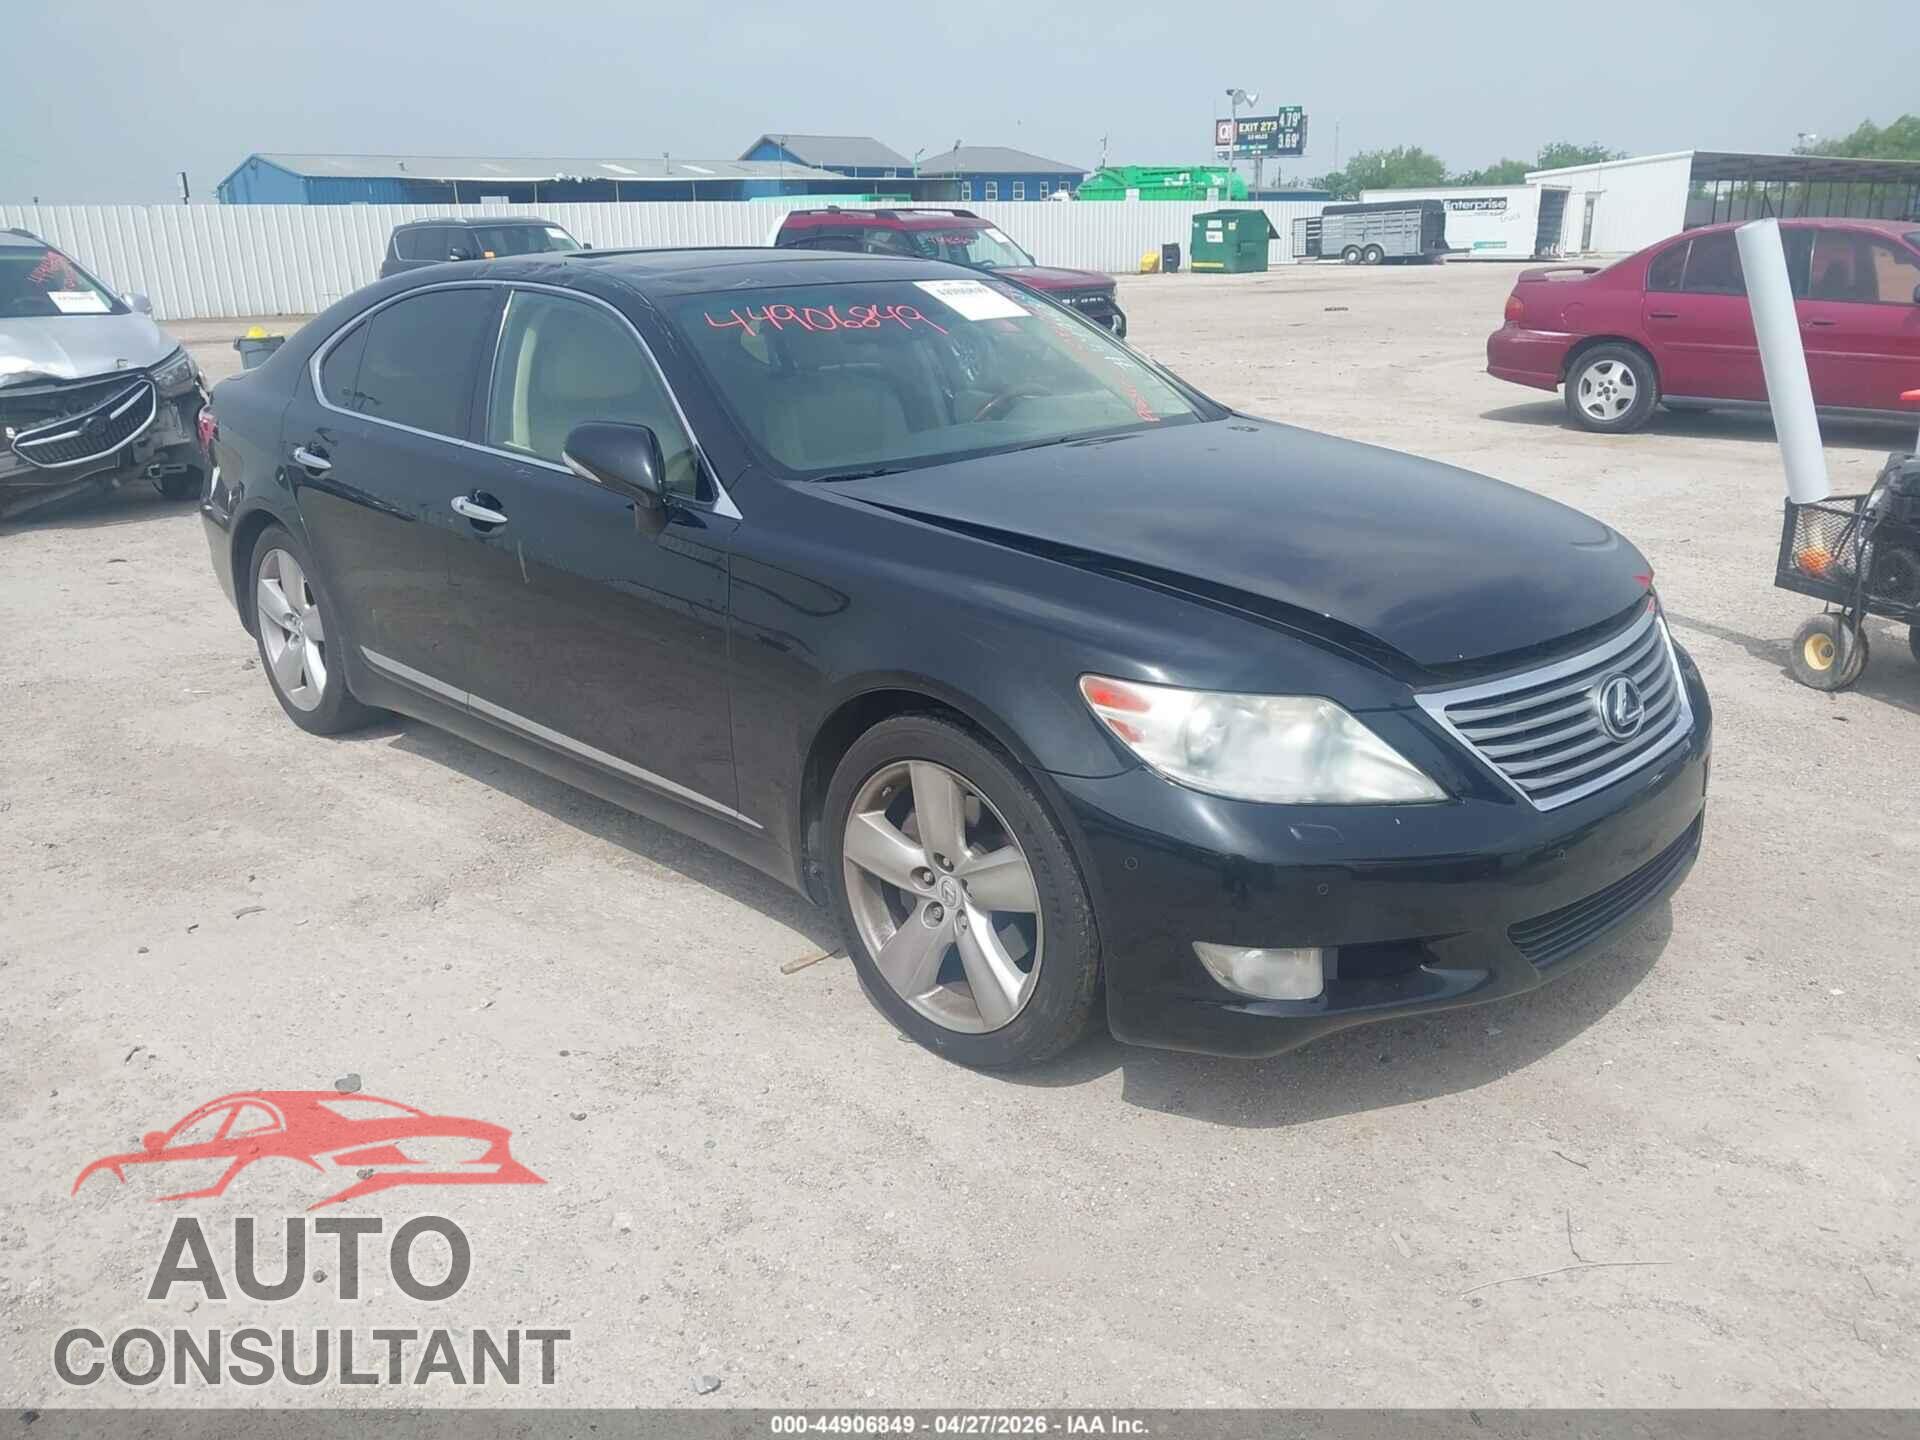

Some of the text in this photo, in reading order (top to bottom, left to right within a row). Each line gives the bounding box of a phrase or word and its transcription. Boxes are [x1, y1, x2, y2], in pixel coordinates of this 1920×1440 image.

[1239, 121, 1278, 132] EXIT 273
[1443, 199, 1506, 211] Enterprise
[704, 304, 948, 336] 44906849
